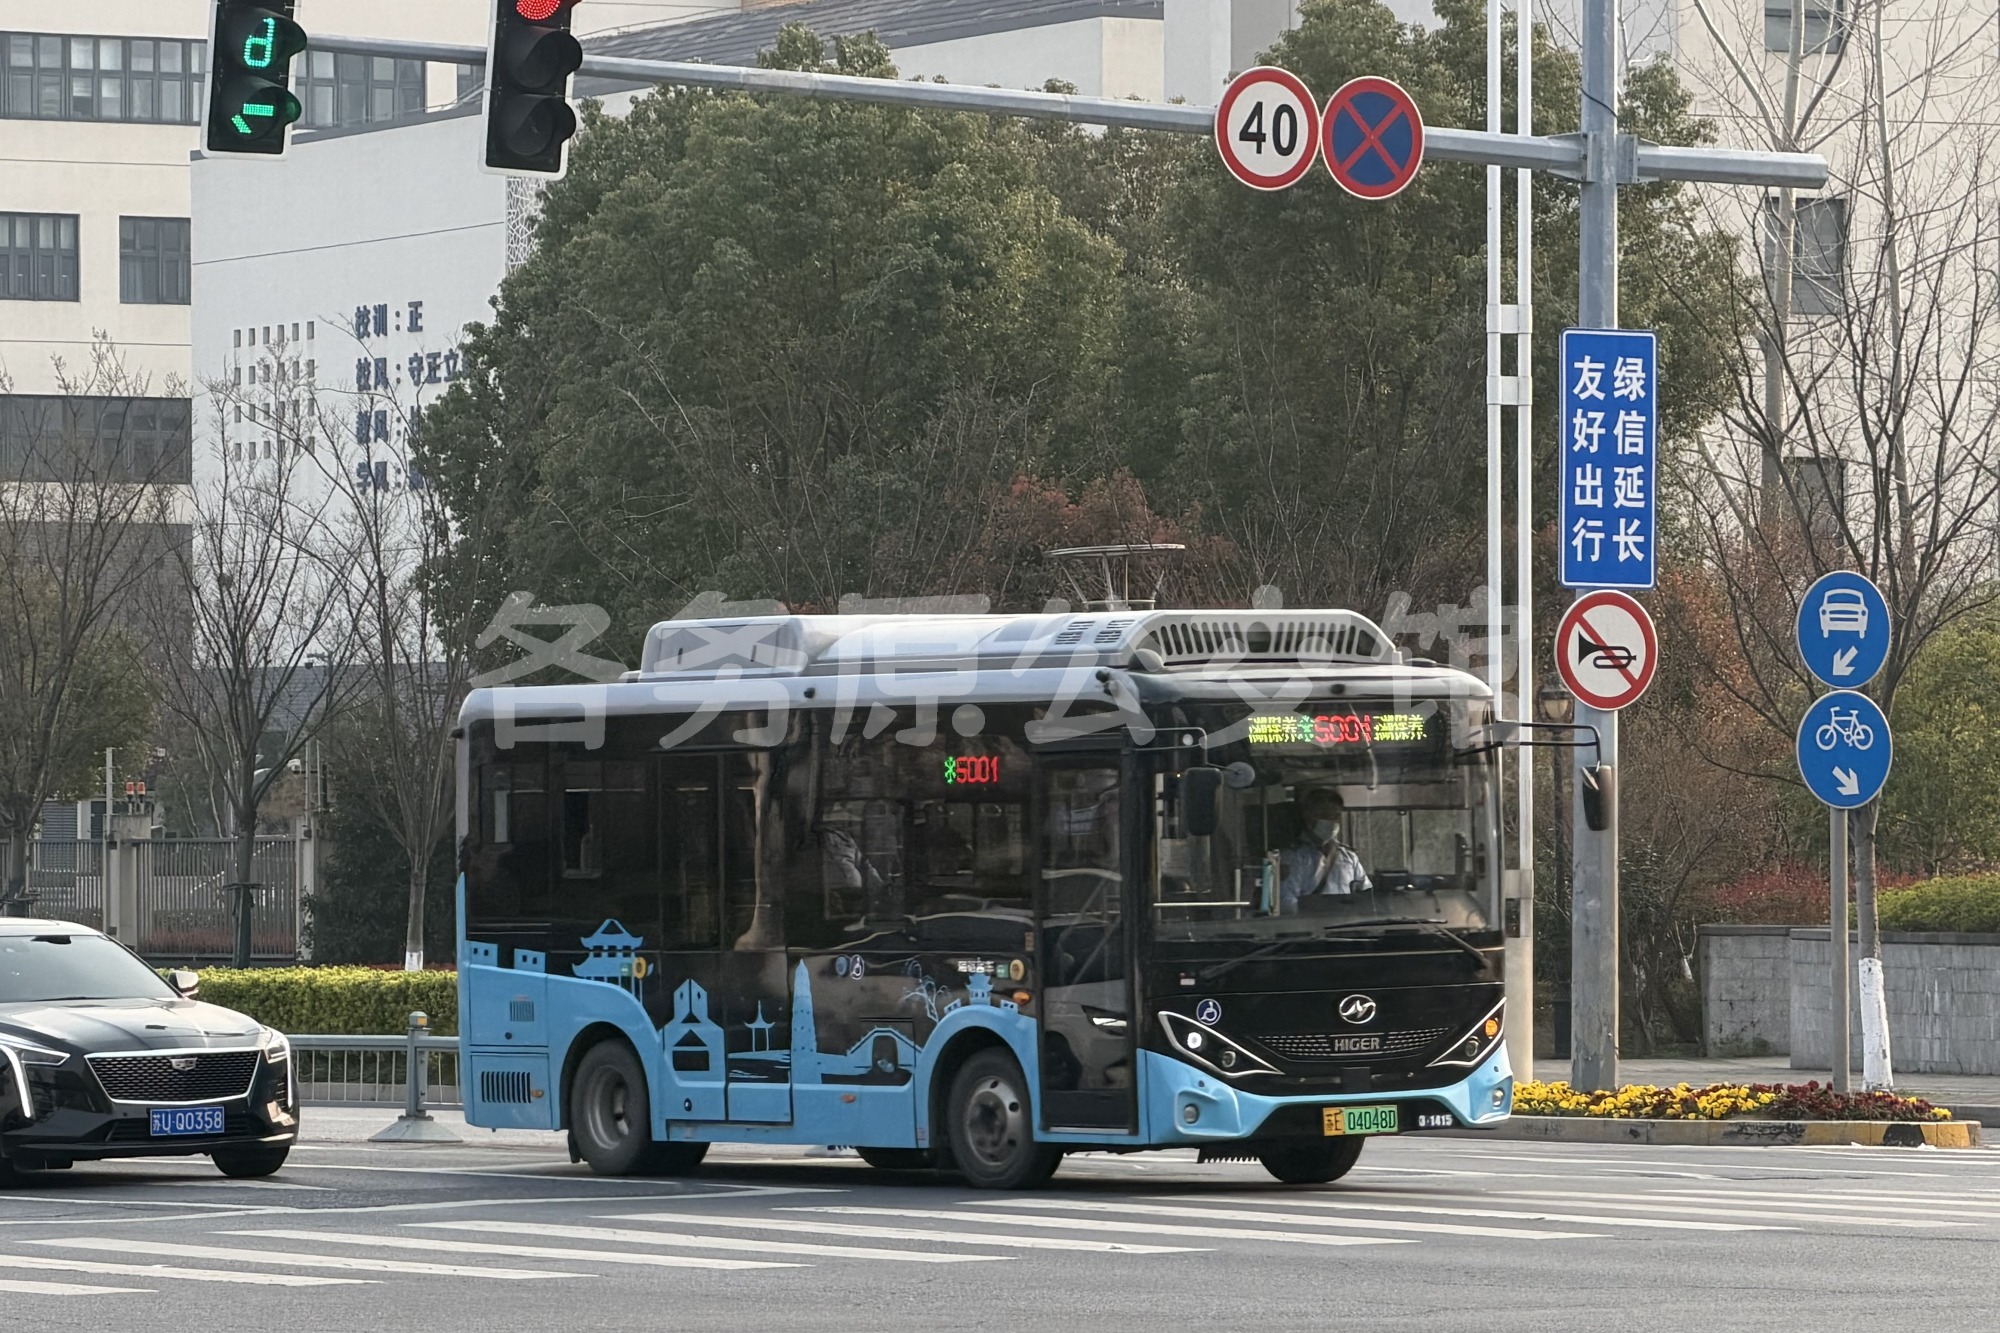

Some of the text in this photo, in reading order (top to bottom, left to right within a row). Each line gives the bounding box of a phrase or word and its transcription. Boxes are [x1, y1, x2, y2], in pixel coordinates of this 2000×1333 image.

[1239, 101, 1298, 156] 40
[356, 348, 470, 391] 校风：守正立
[1571, 355, 1606, 562] 友好出行
[1612, 356, 1646, 563] 绿信延长
[956, 756, 999, 783] 5001
[1334, 1037, 1380, 1052] HIGER
